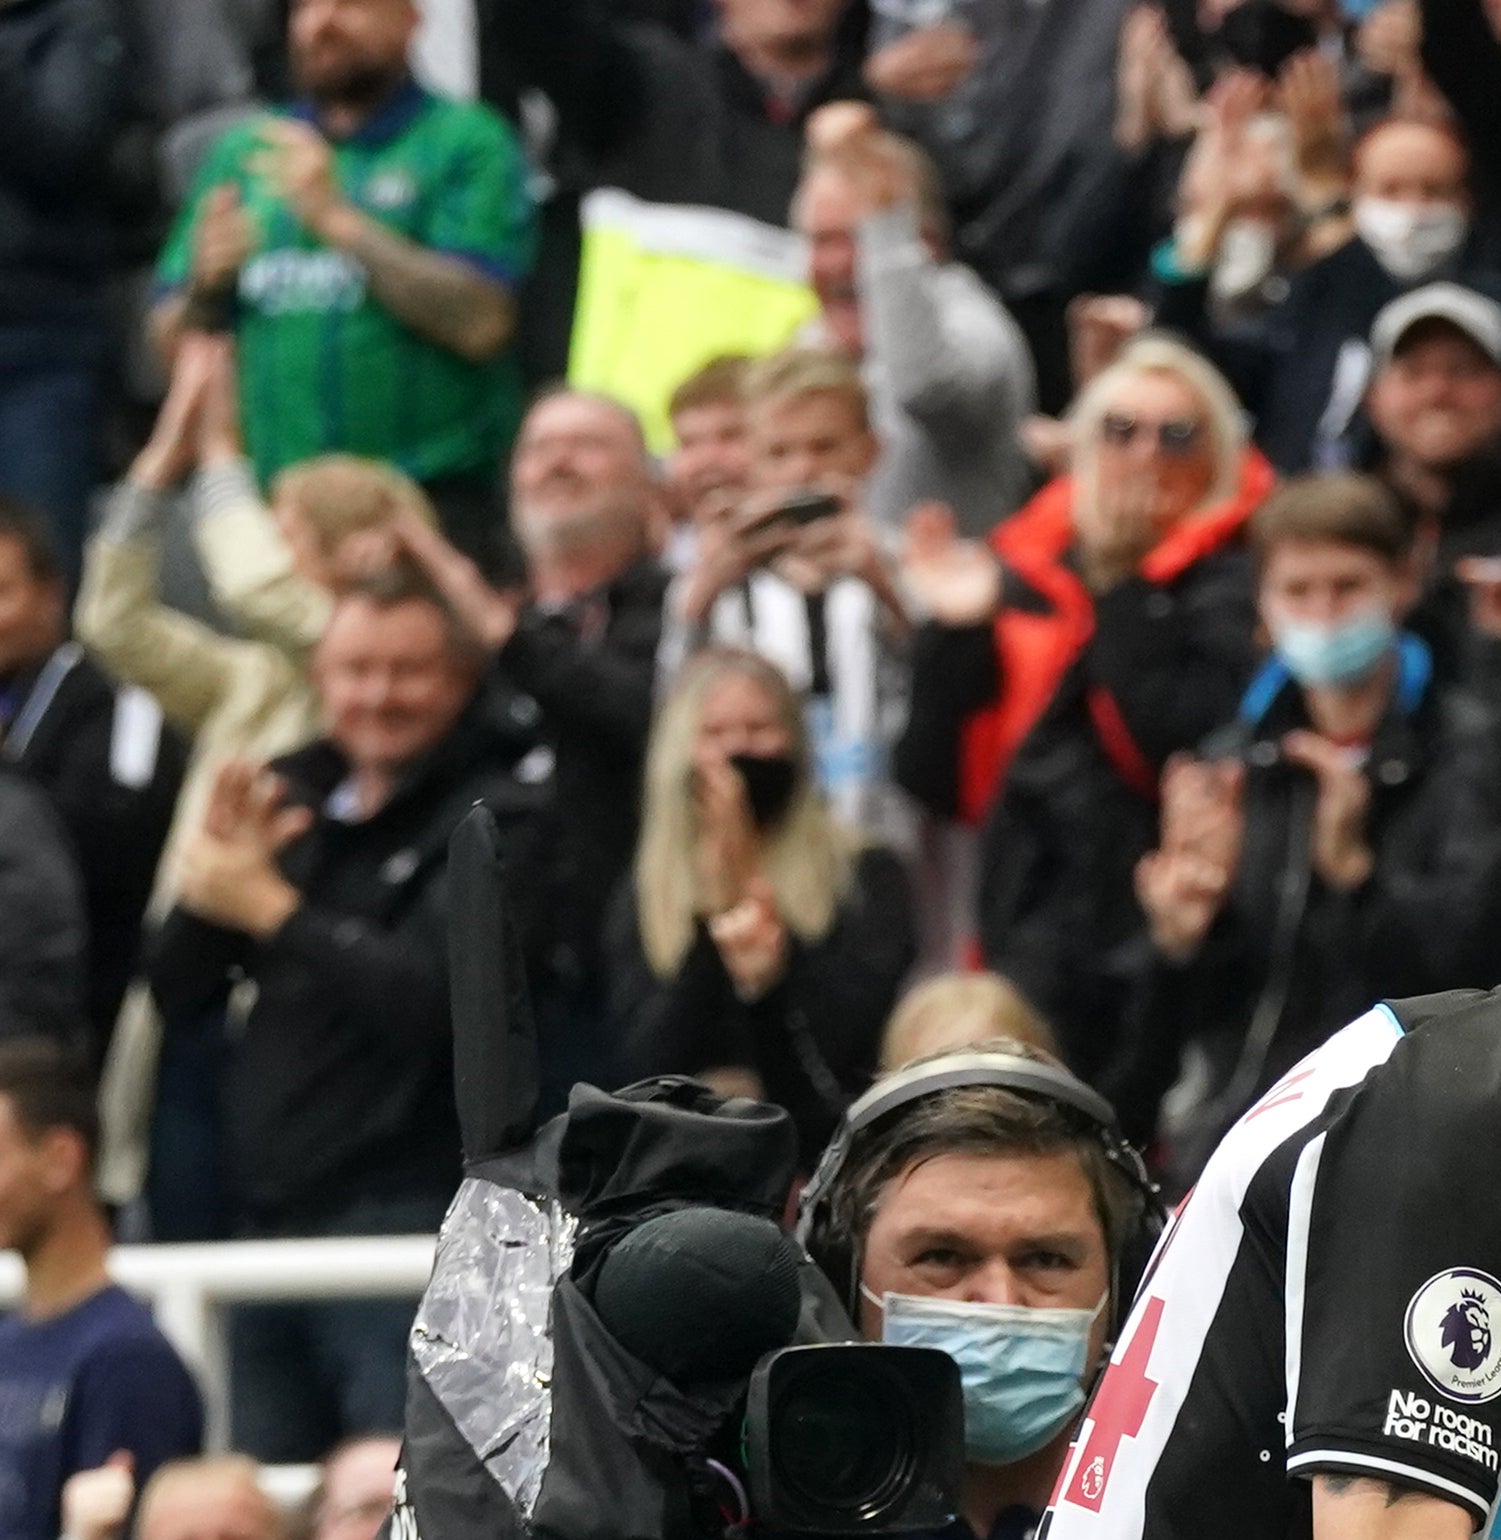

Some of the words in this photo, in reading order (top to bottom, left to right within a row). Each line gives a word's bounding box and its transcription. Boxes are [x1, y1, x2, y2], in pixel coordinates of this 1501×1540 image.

[1451, 1374, 1486, 1389] Premier
[1388, 1389, 1431, 1420] No
[1433, 1404, 1493, 1446] room
[1429, 1425, 1498, 1471] racism
